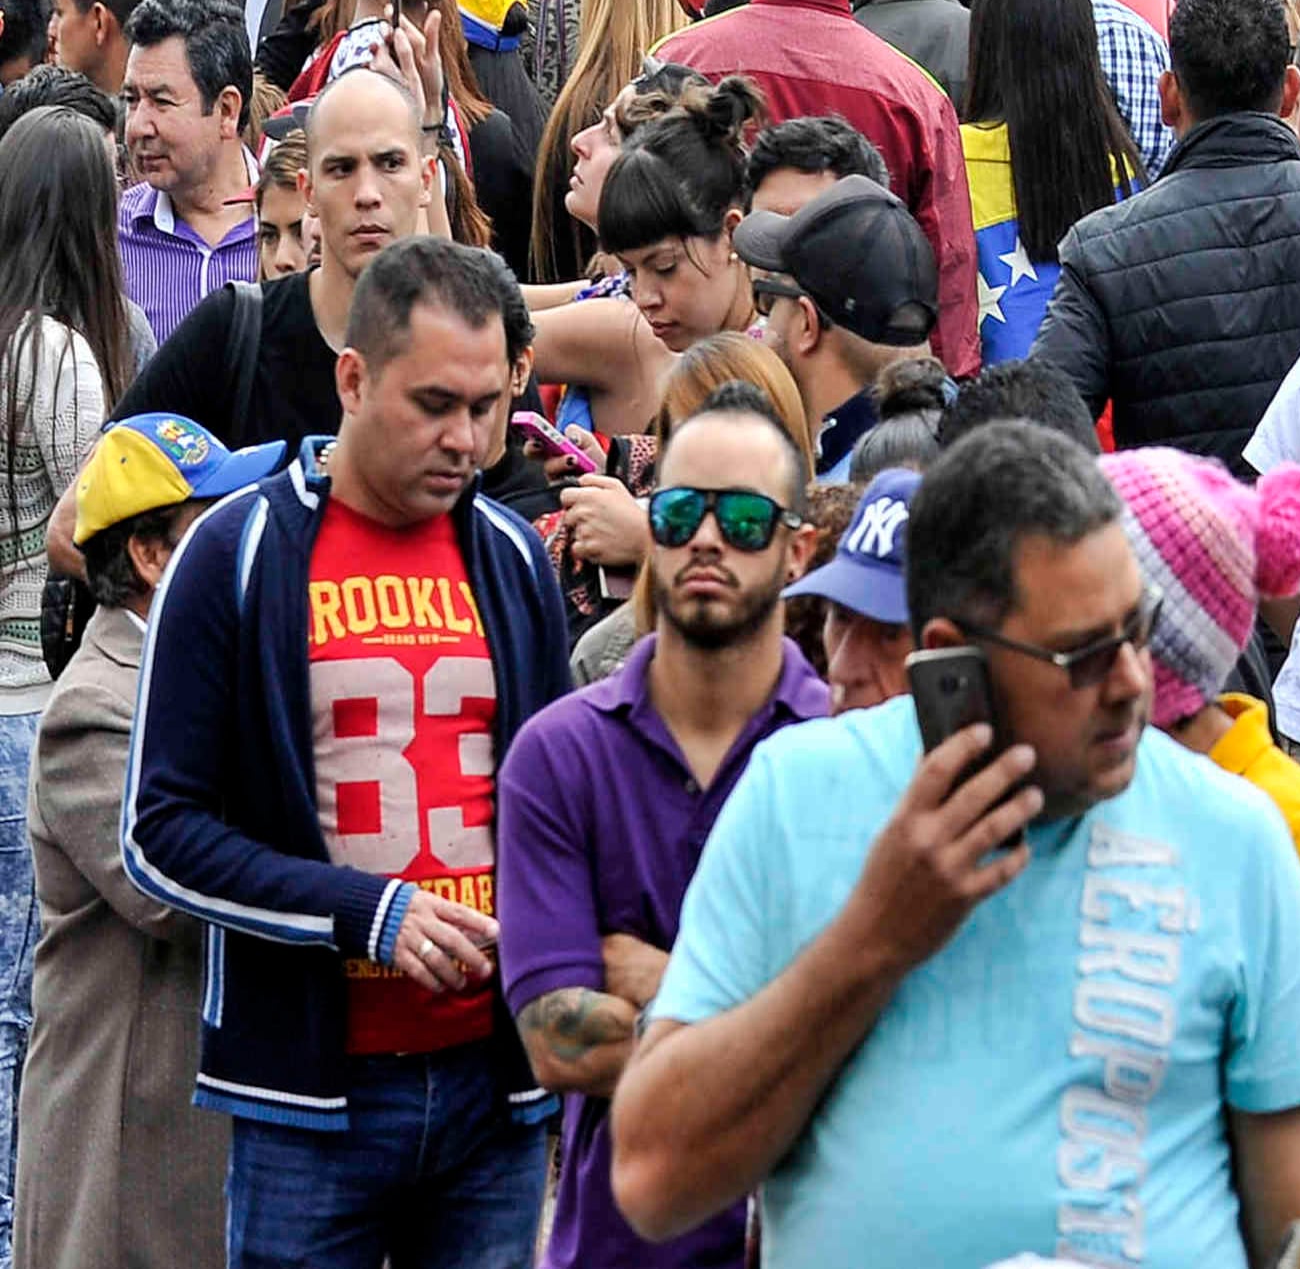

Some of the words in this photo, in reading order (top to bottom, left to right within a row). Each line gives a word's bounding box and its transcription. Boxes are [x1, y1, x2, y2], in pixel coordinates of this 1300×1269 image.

[848, 497, 910, 558] NY
[309, 575, 486, 645] ROOKL
[309, 657, 497, 874] 83
